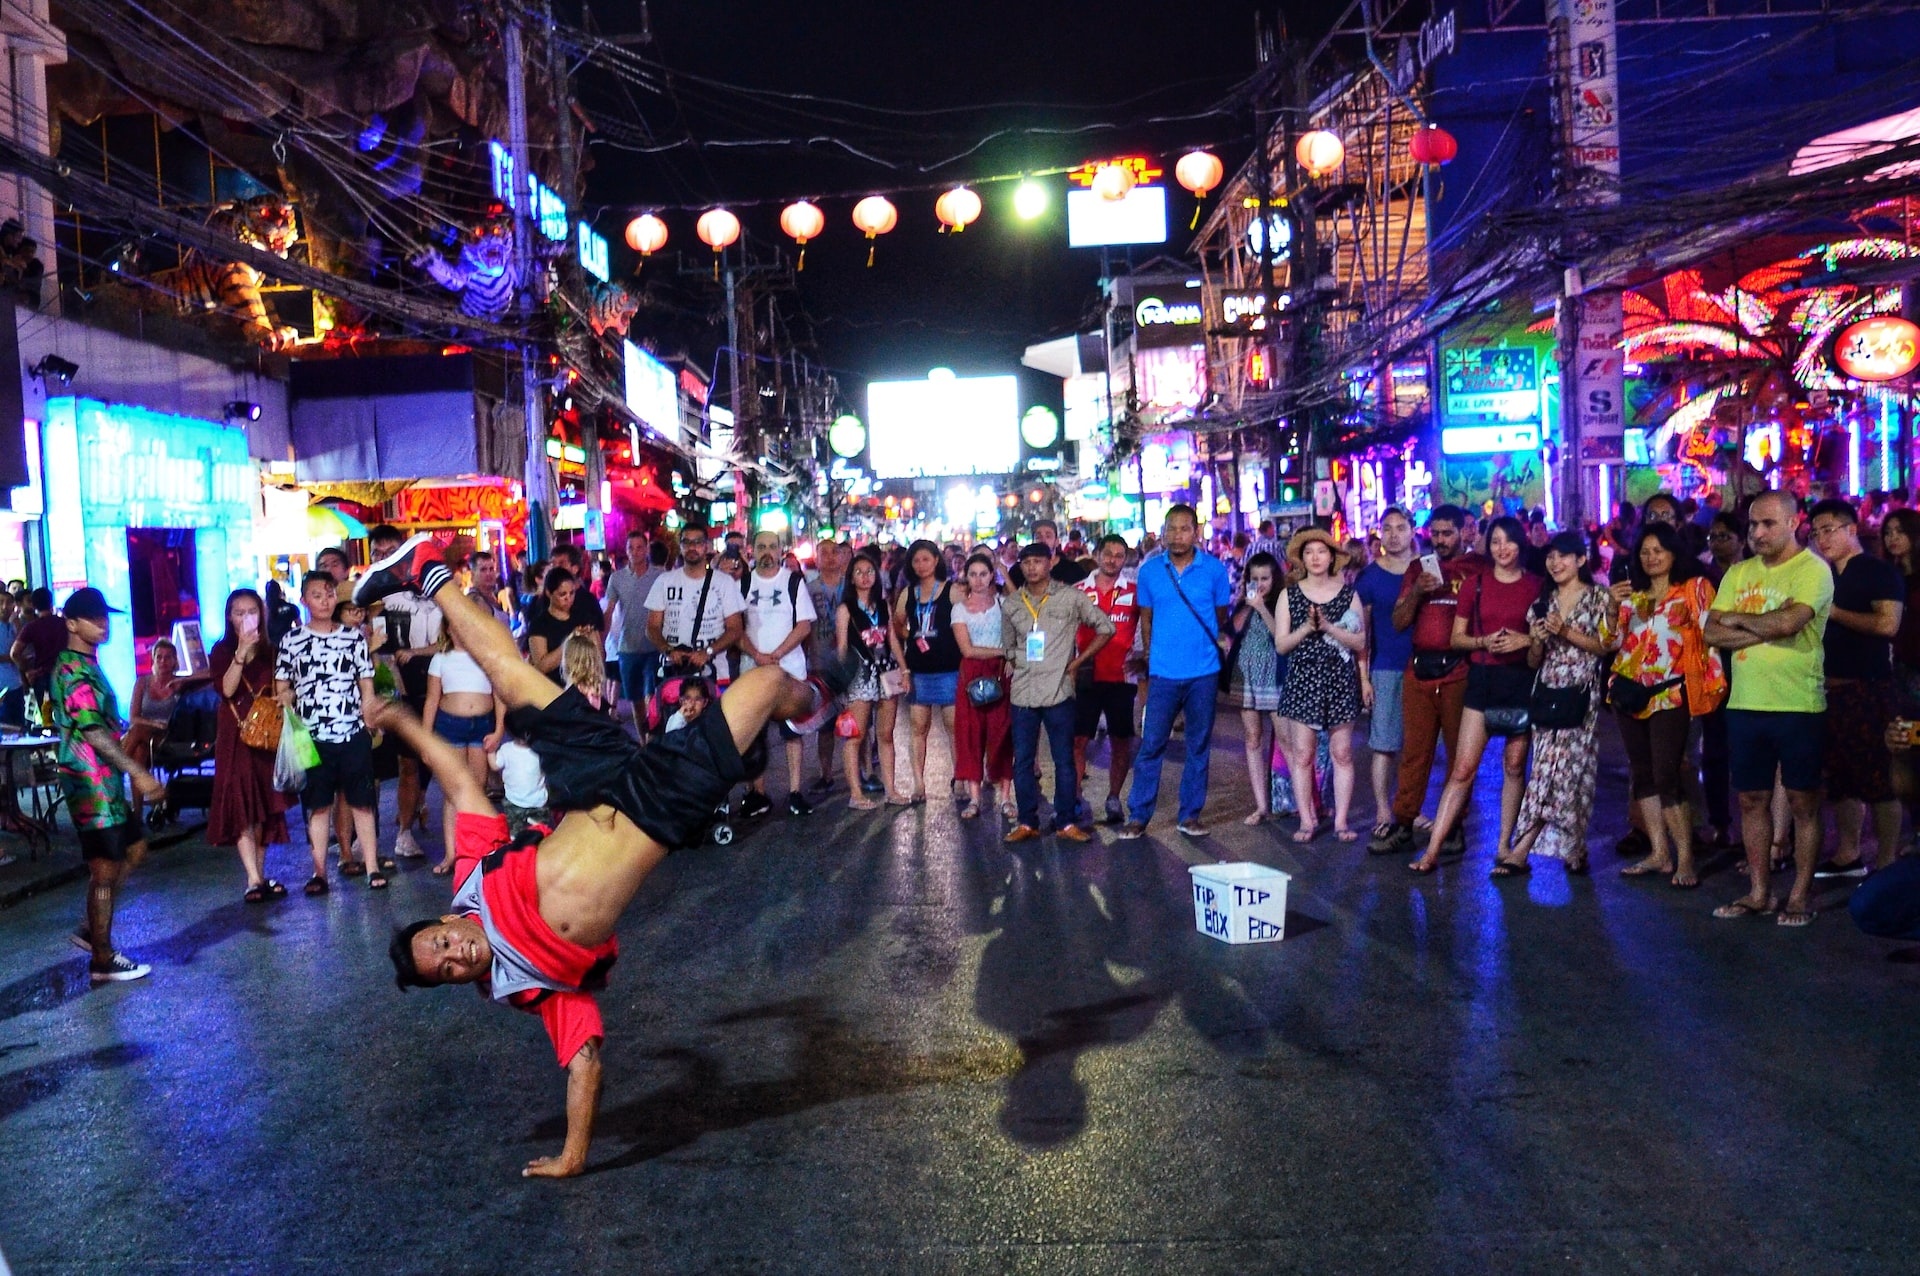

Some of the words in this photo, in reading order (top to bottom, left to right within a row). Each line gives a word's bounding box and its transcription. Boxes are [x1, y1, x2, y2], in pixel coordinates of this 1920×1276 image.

[1418, 8, 1454, 67] Chang
[667, 587, 683, 601] 01
[1233, 885, 1270, 906] TIP
[1204, 908, 1229, 939] BOX
